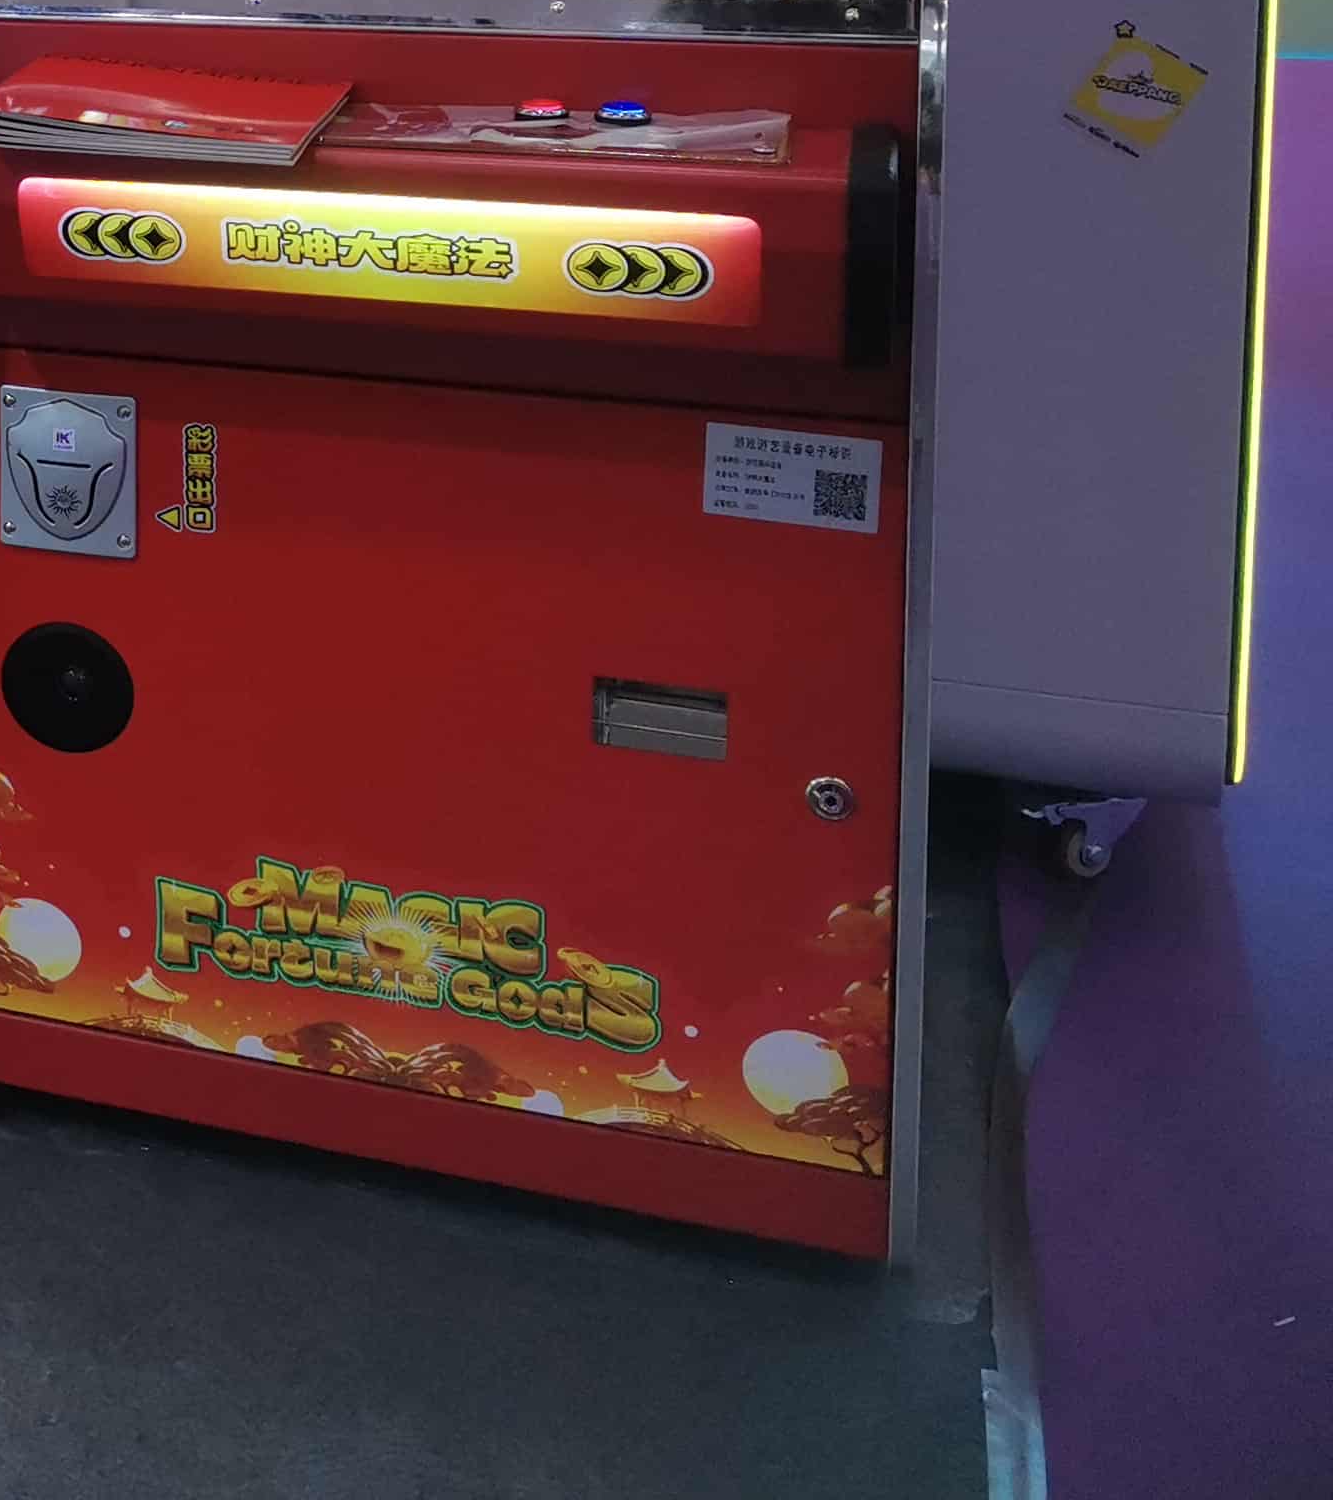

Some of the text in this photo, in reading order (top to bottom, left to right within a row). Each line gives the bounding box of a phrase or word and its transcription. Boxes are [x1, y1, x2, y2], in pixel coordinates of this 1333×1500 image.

[225, 221, 516, 280] 财神大魔法
[185, 424, 215, 532] 彩票出口
